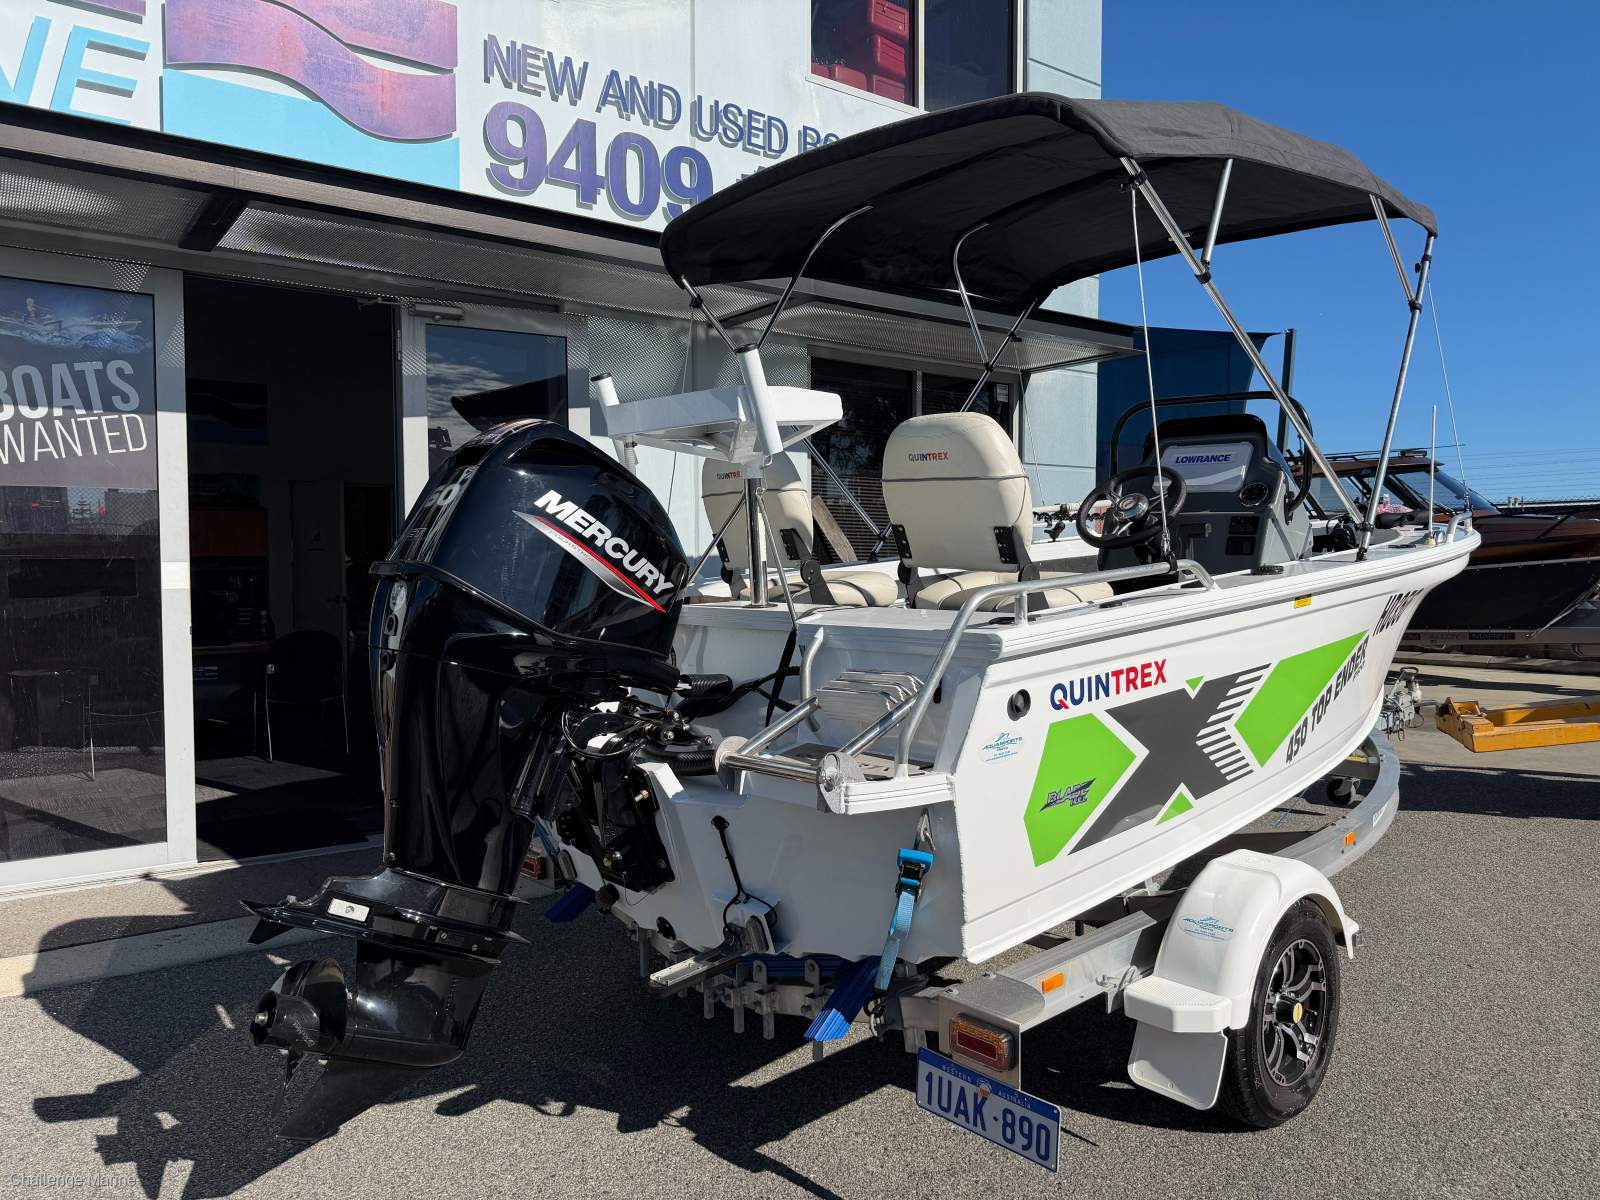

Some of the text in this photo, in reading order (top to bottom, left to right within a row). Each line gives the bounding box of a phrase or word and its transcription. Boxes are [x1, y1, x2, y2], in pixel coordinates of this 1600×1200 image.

[484, 33, 589, 104] NEW
[597, 69, 682, 128] AND
[693, 95, 788, 157] USED
[484, 101, 714, 220] 9409
[908, 451, 949, 463] QUINTREX
[1175, 454, 1231, 465] LOWRANCE
[534, 489, 674, 598] MERCURY
[1049, 658, 1167, 711] QUINTREX
[1285, 720, 1309, 765] 450
[1311, 686, 1332, 733] TOP
